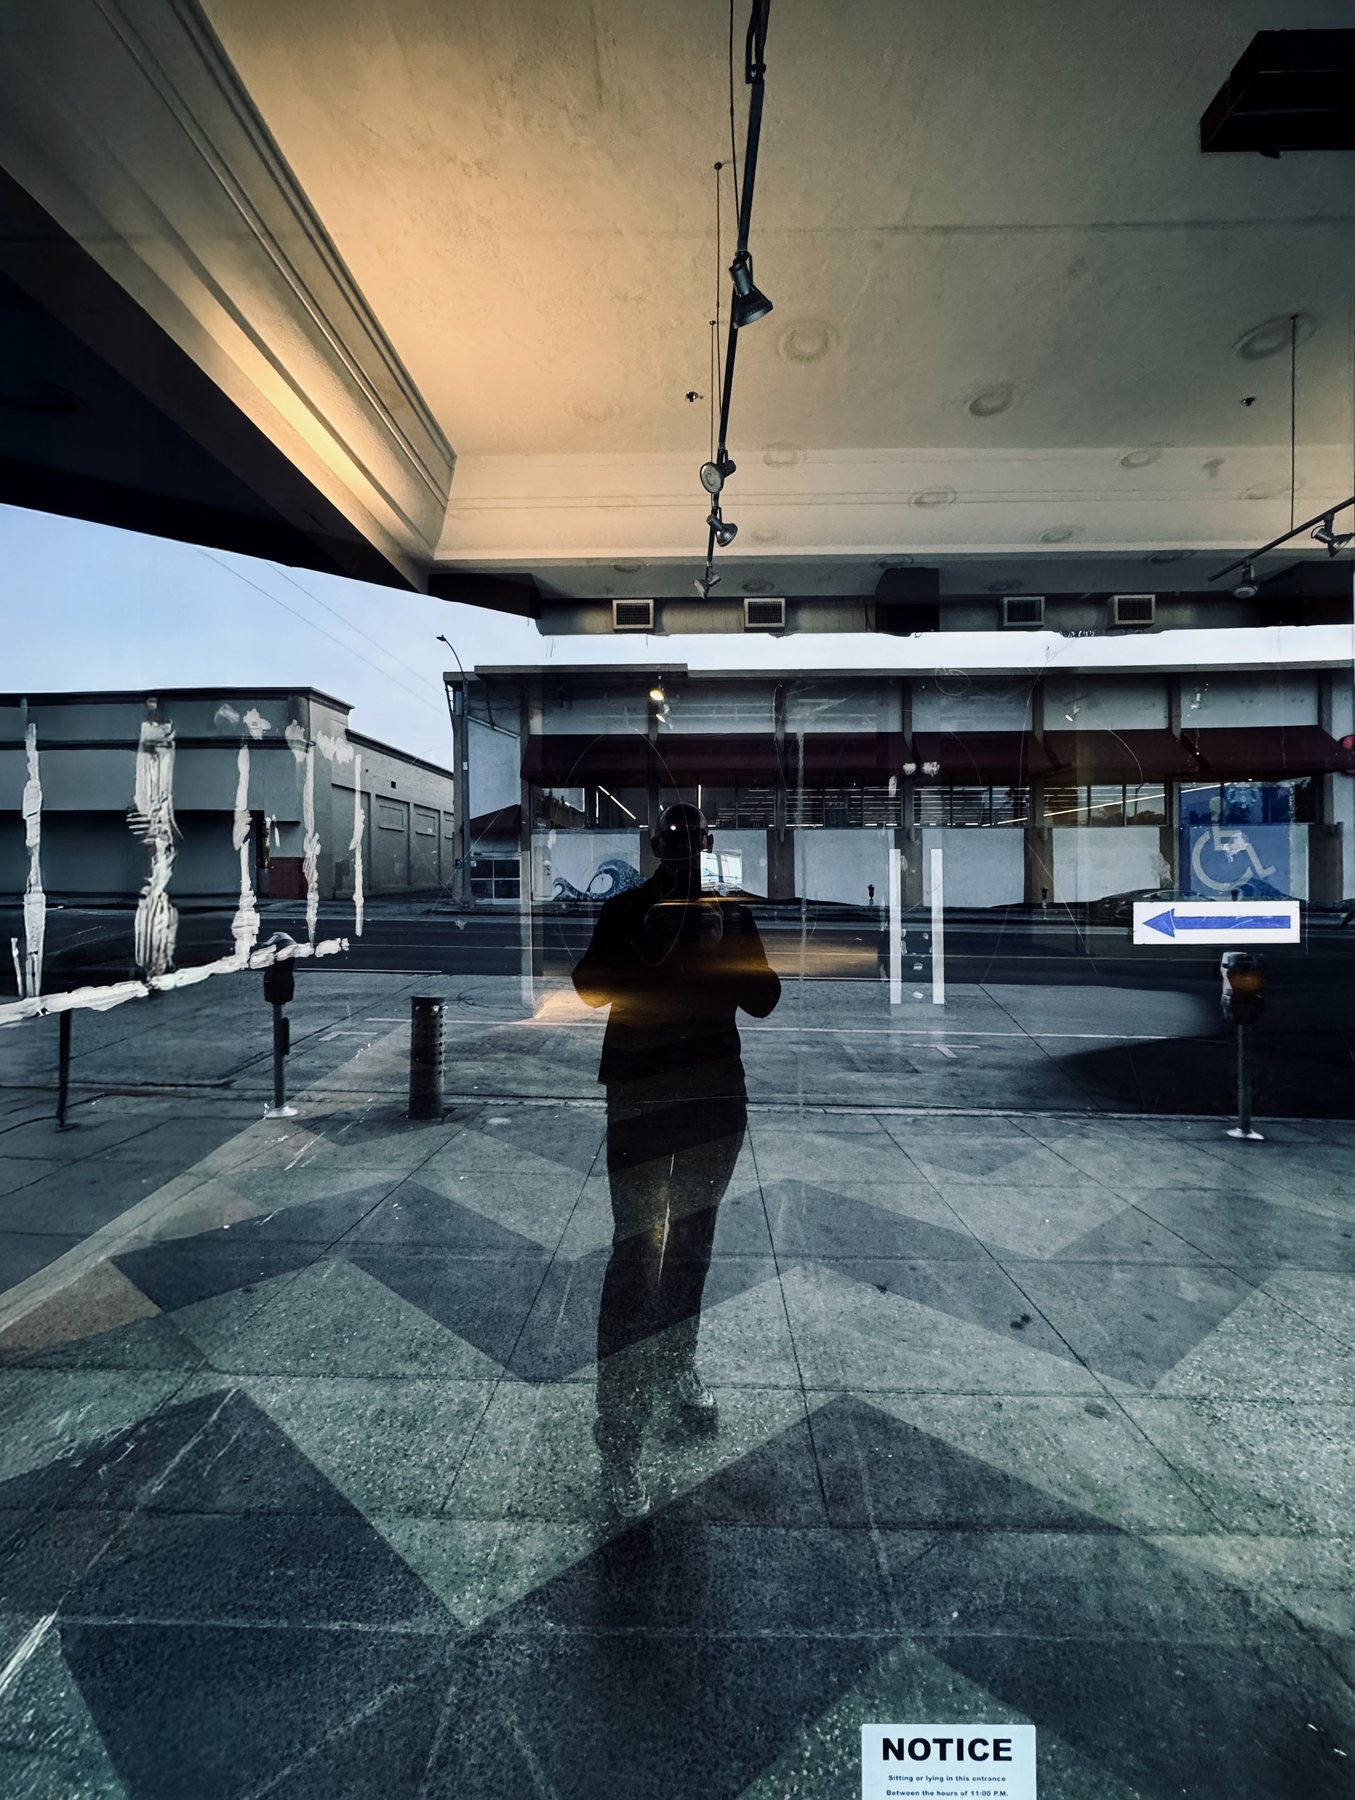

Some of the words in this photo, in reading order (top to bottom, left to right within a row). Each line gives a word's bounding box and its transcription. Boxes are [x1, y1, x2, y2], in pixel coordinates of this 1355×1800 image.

[882, 1737, 1013, 1762] NOTICE
[888, 1774, 914, 1783] Sitting
[925, 1775, 944, 1783] lying
[936, 1789, 958, 1797] hours
[960, 1789, 968, 1797] of
[970, 1789, 992, 1797] 11:00
[993, 1789, 1009, 1797] P.M.
